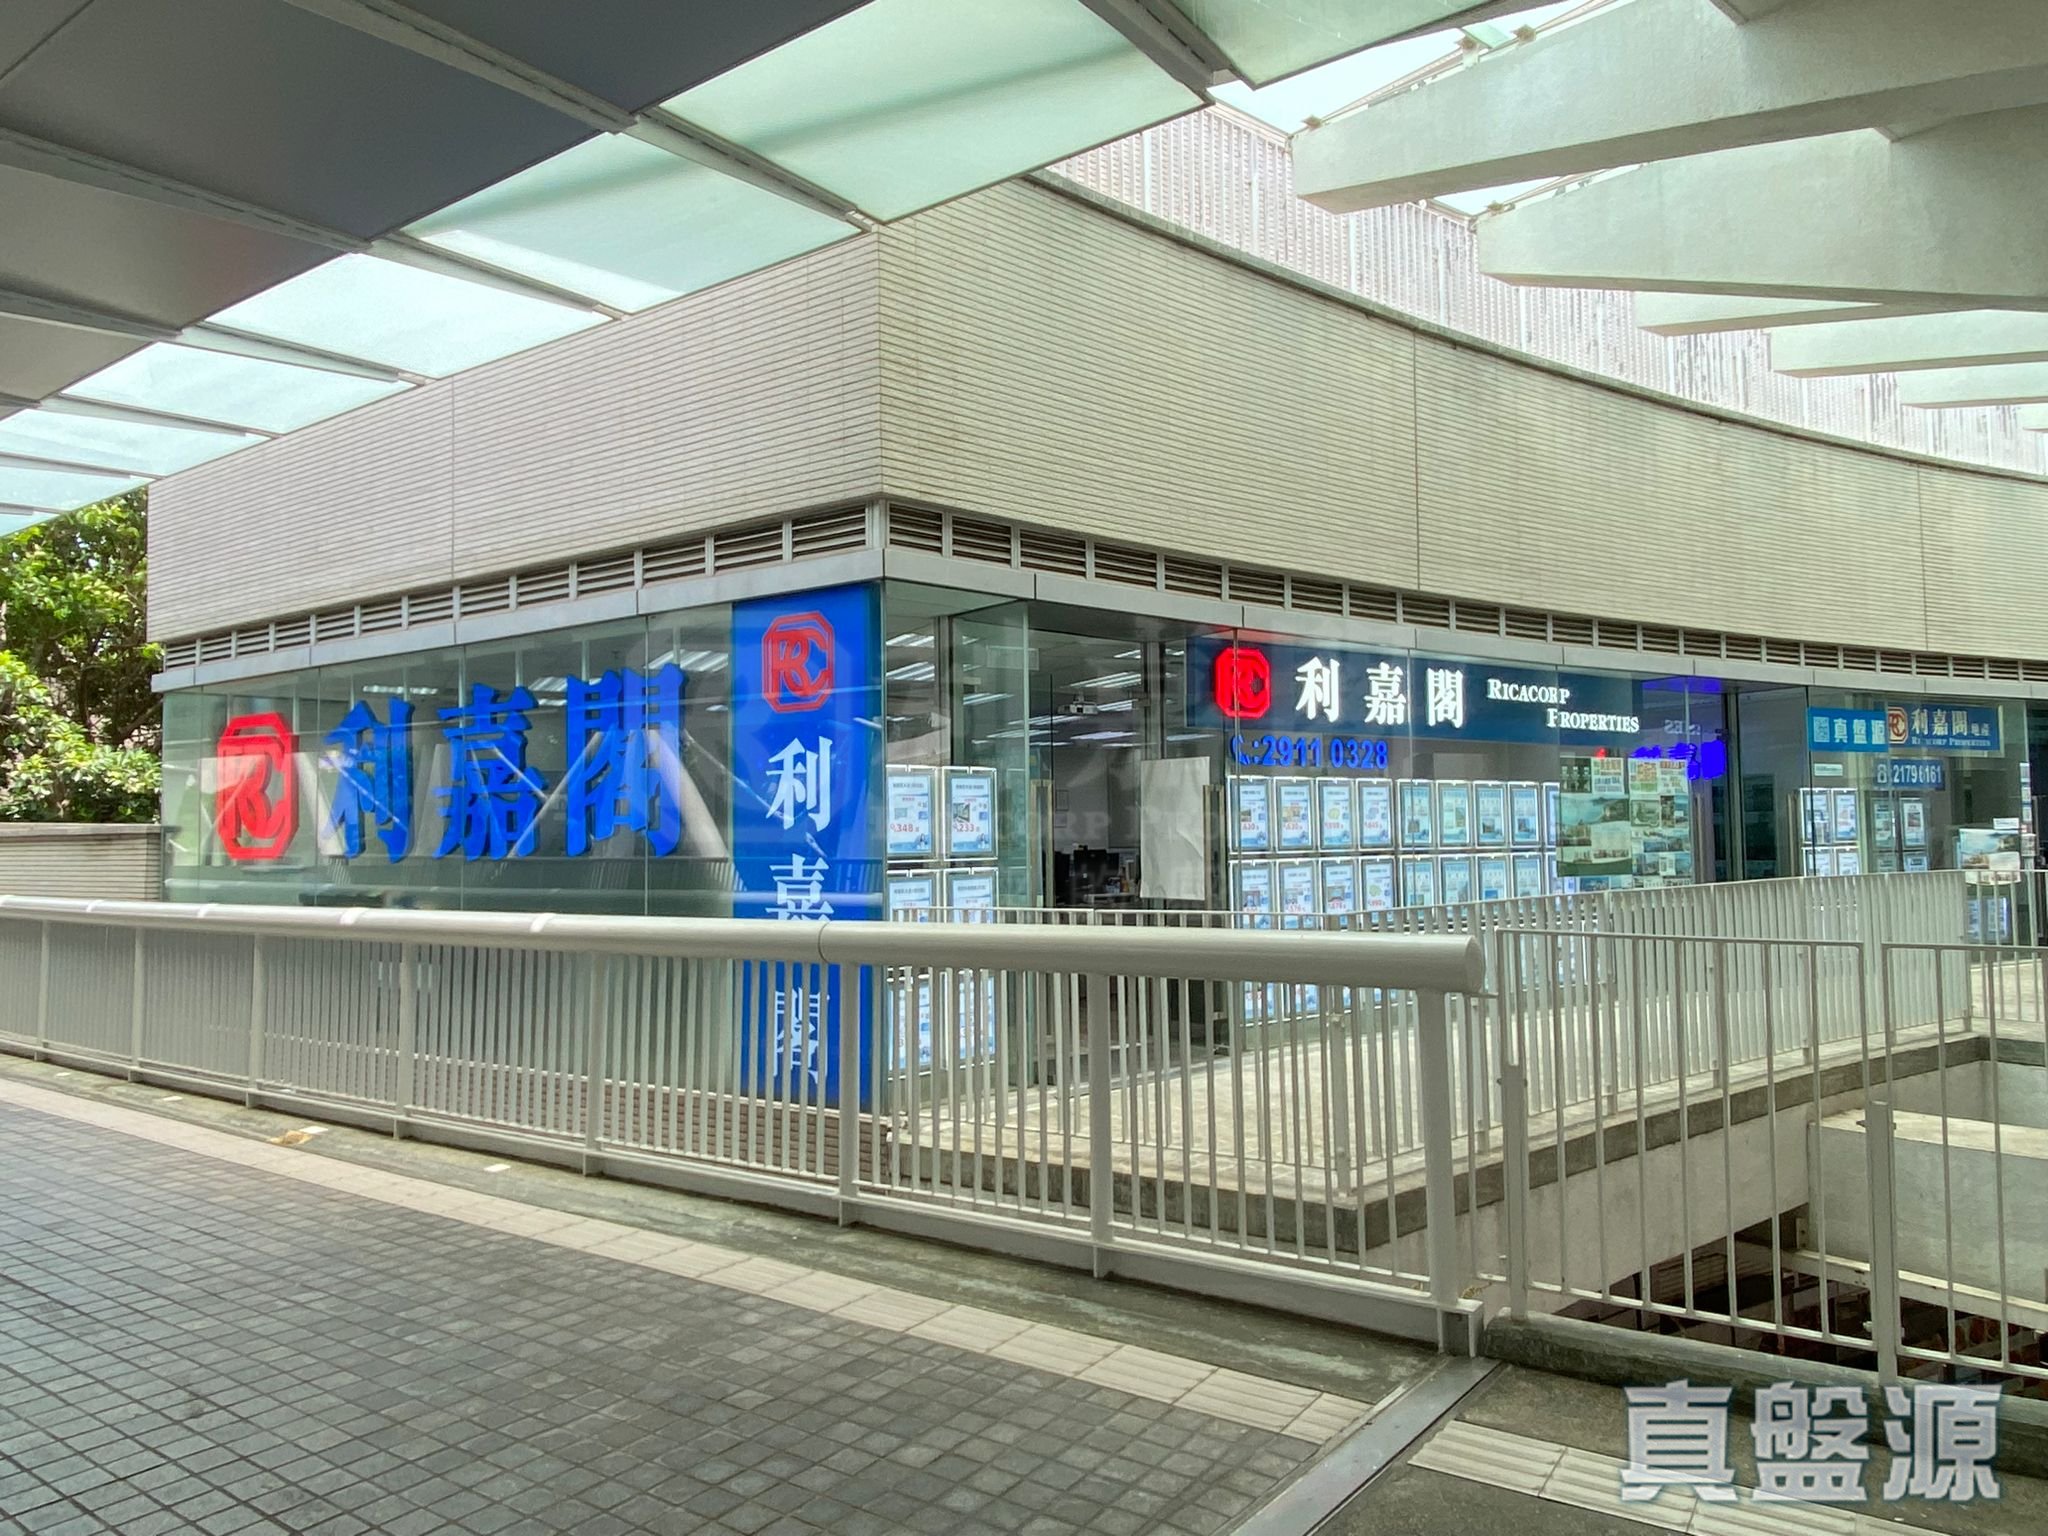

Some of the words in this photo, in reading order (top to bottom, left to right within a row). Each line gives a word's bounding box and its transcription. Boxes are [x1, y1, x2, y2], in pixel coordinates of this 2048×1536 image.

[1295, 656, 1464, 728] 利嘉閣
[319, 663, 688, 863] 利嘉閣
[1330, 738, 1388, 769] 0328
